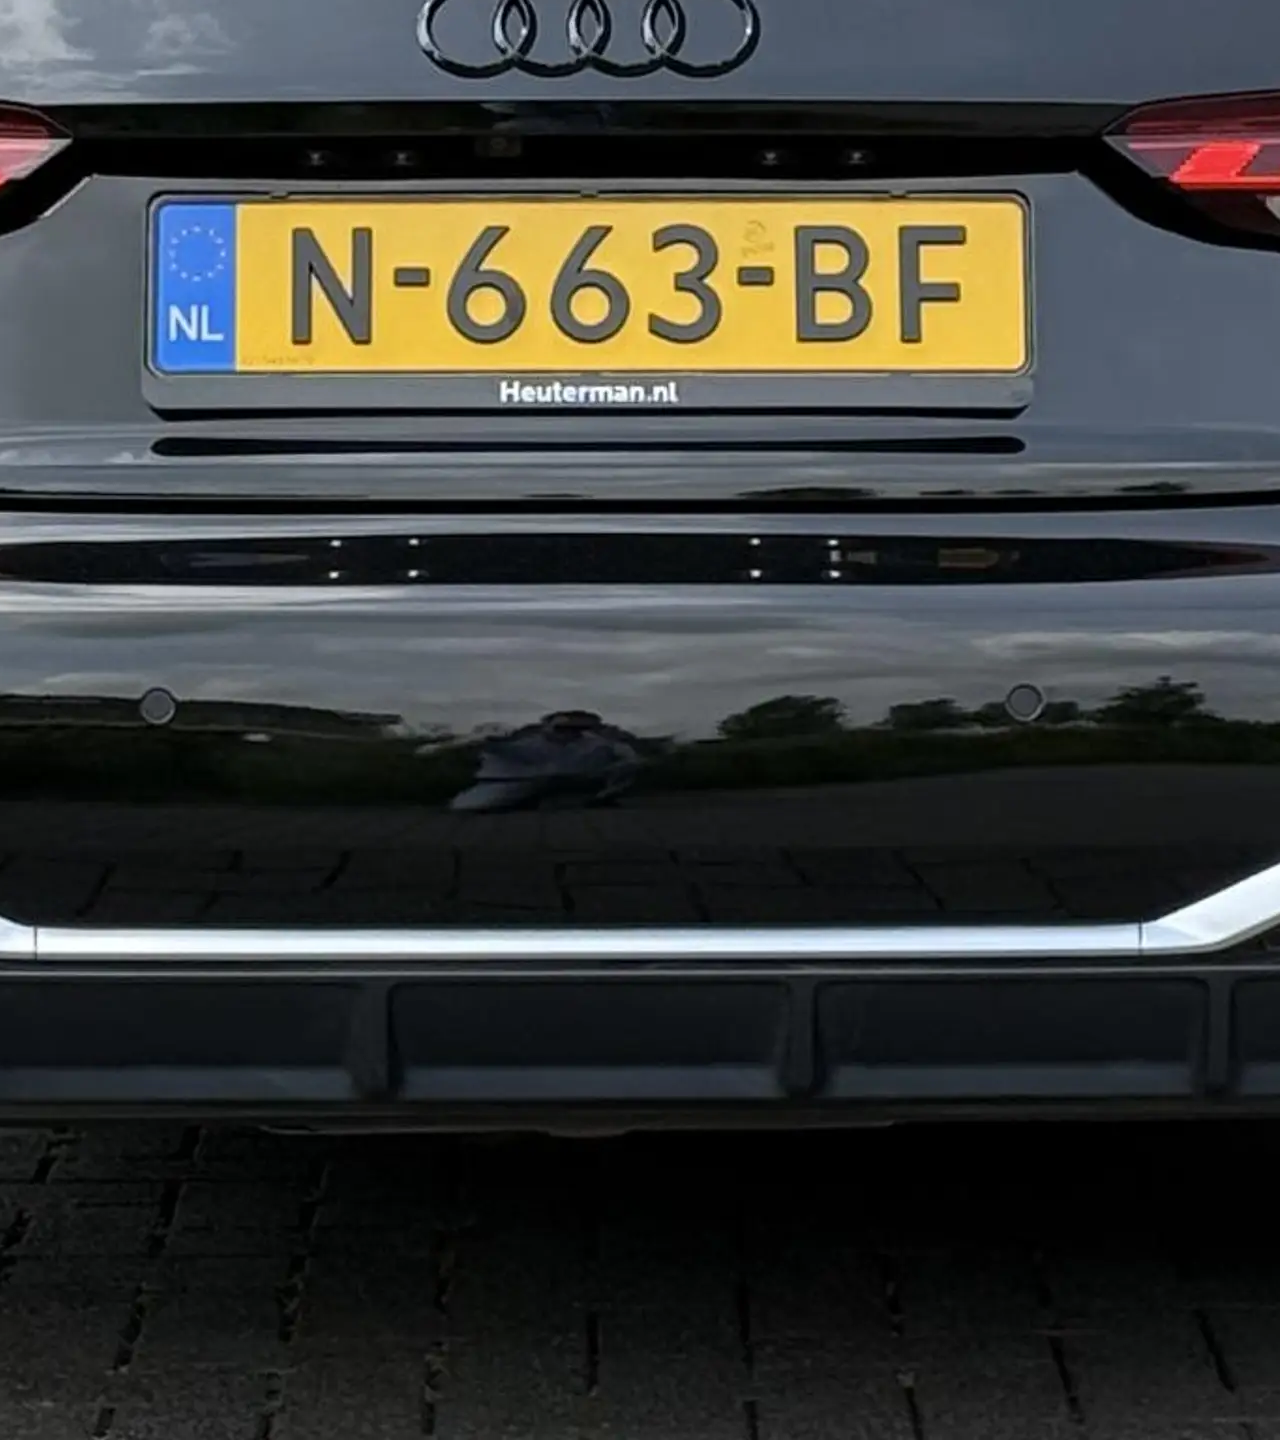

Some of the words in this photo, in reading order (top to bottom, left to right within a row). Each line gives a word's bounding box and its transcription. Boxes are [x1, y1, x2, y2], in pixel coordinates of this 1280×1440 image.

[291, 224, 967, 345] N-663-BF
[169, 305, 224, 341] NL
[499, 380, 679, 403] Heuterman.nl
